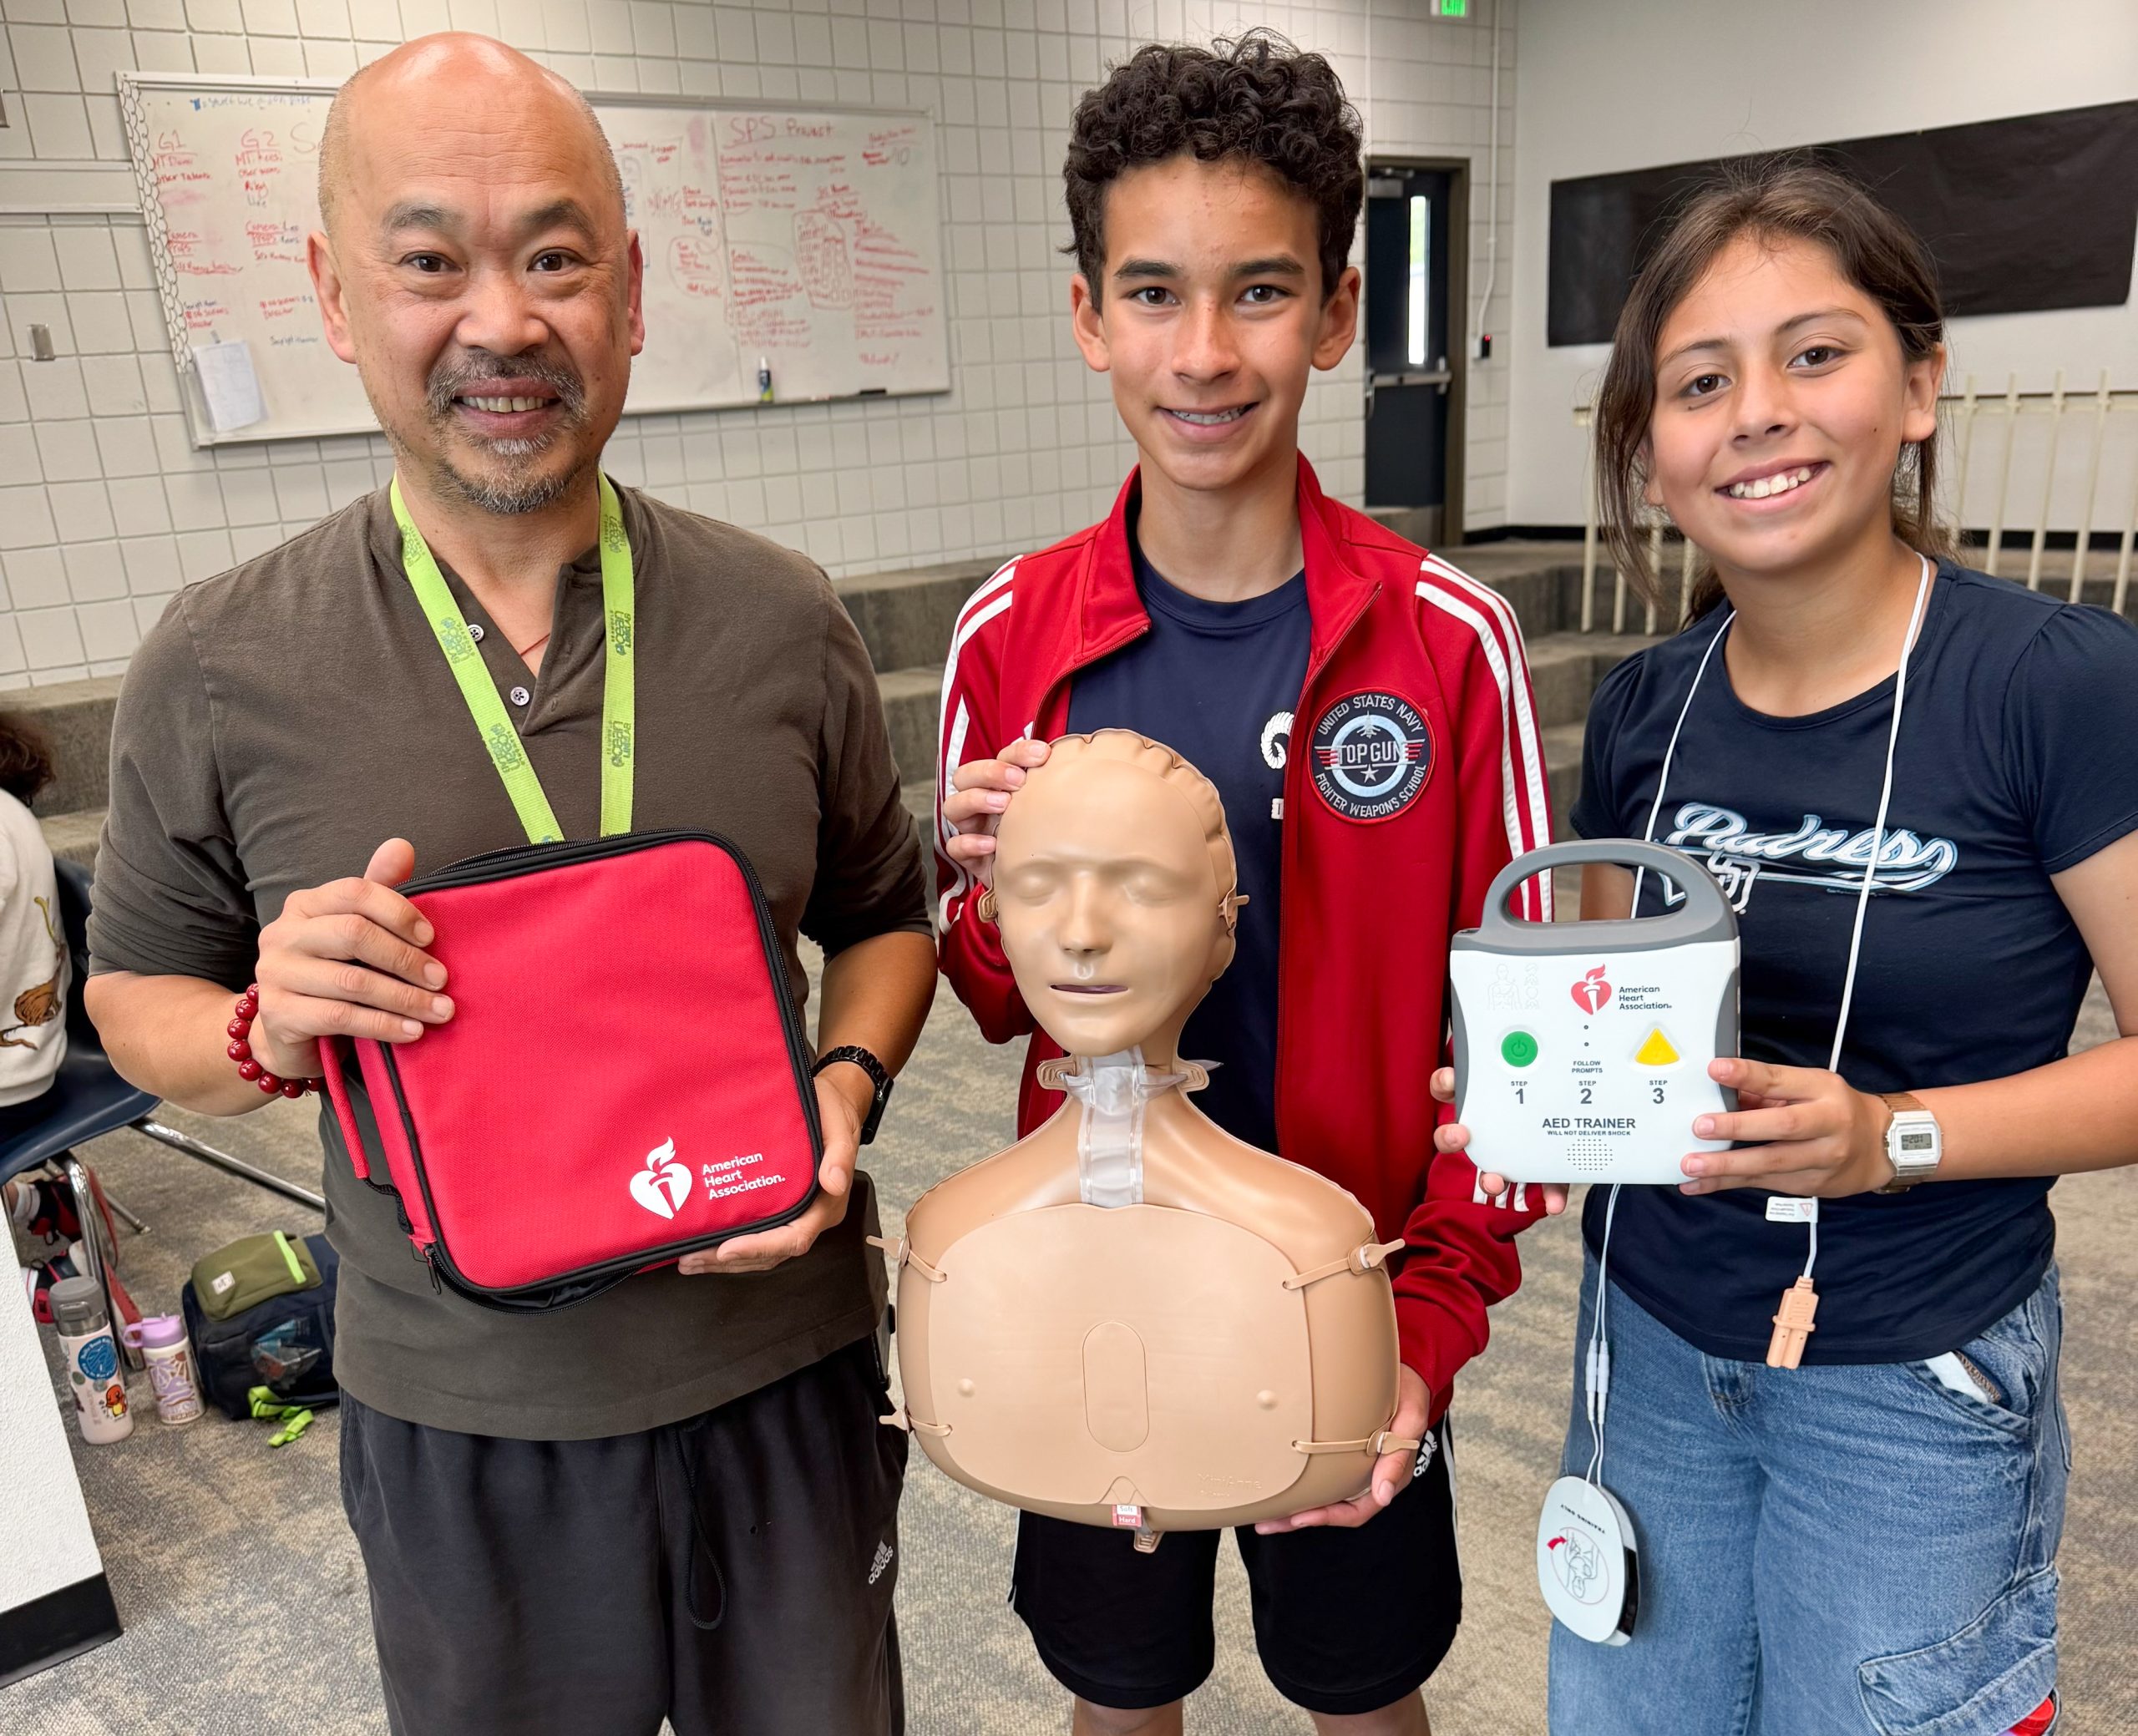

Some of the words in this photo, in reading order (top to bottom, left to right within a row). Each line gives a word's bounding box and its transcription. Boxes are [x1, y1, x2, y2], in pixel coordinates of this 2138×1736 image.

[158, 129, 187, 151] G1
[241, 128, 279, 154] G2
[729, 116, 777, 144] SPS
[1318, 702, 1350, 736] UNITED
[1353, 695, 1396, 710] STATES
[1396, 703, 1424, 733] NAVY
[1337, 742, 1368, 765] TOP
[1370, 740, 1406, 763] GUN
[1315, 772, 1348, 811] FIGHTER
[1398, 764, 1427, 802] SCHOOL
[1669, 802, 1958, 873] Padres
[1619, 985, 1660, 995] American
[1619, 994, 1644, 1002] Heart
[1515, 1088, 1524, 1105] 1
[1580, 1088, 1593, 1105] 2
[1652, 1087, 1664, 1105] 3
[1542, 1118, 1571, 1129] AED
[1573, 1117, 1636, 1129] TRAINER
[702, 1152, 763, 1176] American
[704, 1169, 743, 1188] Heart
[1118, 1516, 1136, 1524] Hard
[868, 1545, 894, 1585] adidas
